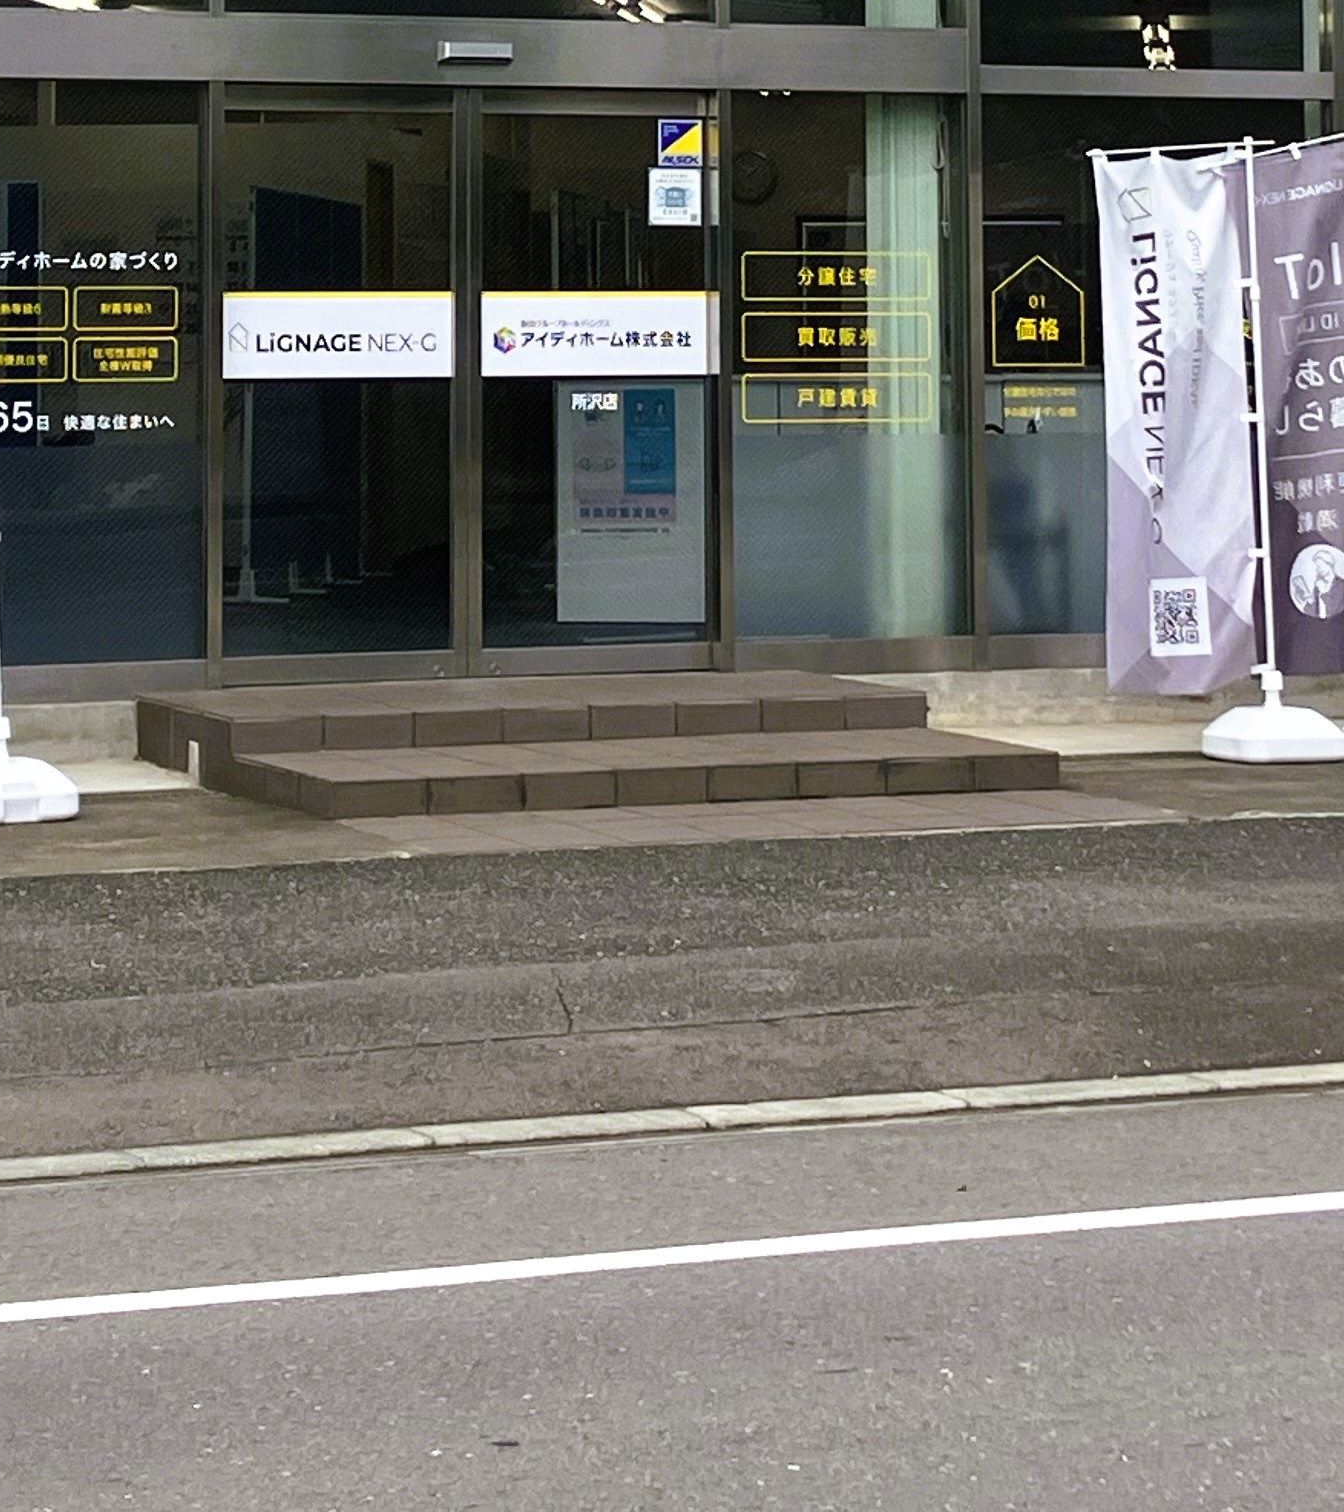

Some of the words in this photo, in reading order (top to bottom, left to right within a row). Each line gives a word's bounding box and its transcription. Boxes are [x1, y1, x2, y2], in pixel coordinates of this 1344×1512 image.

[1028, 294, 1046, 310] 01
[520, 330, 692, 348] アイディホーム株式会社
[797, 326, 879, 348] 買取販売
[1014, 316, 1061, 343] 価格
[255, 331, 362, 353] LiGNAGE
[367, 332, 438, 353] NEX-G
[570, 392, 619, 411] 所沢店
[797, 387, 879, 409] 戸建賃貸
[62, 414, 175, 431] 快適な住まいへ
